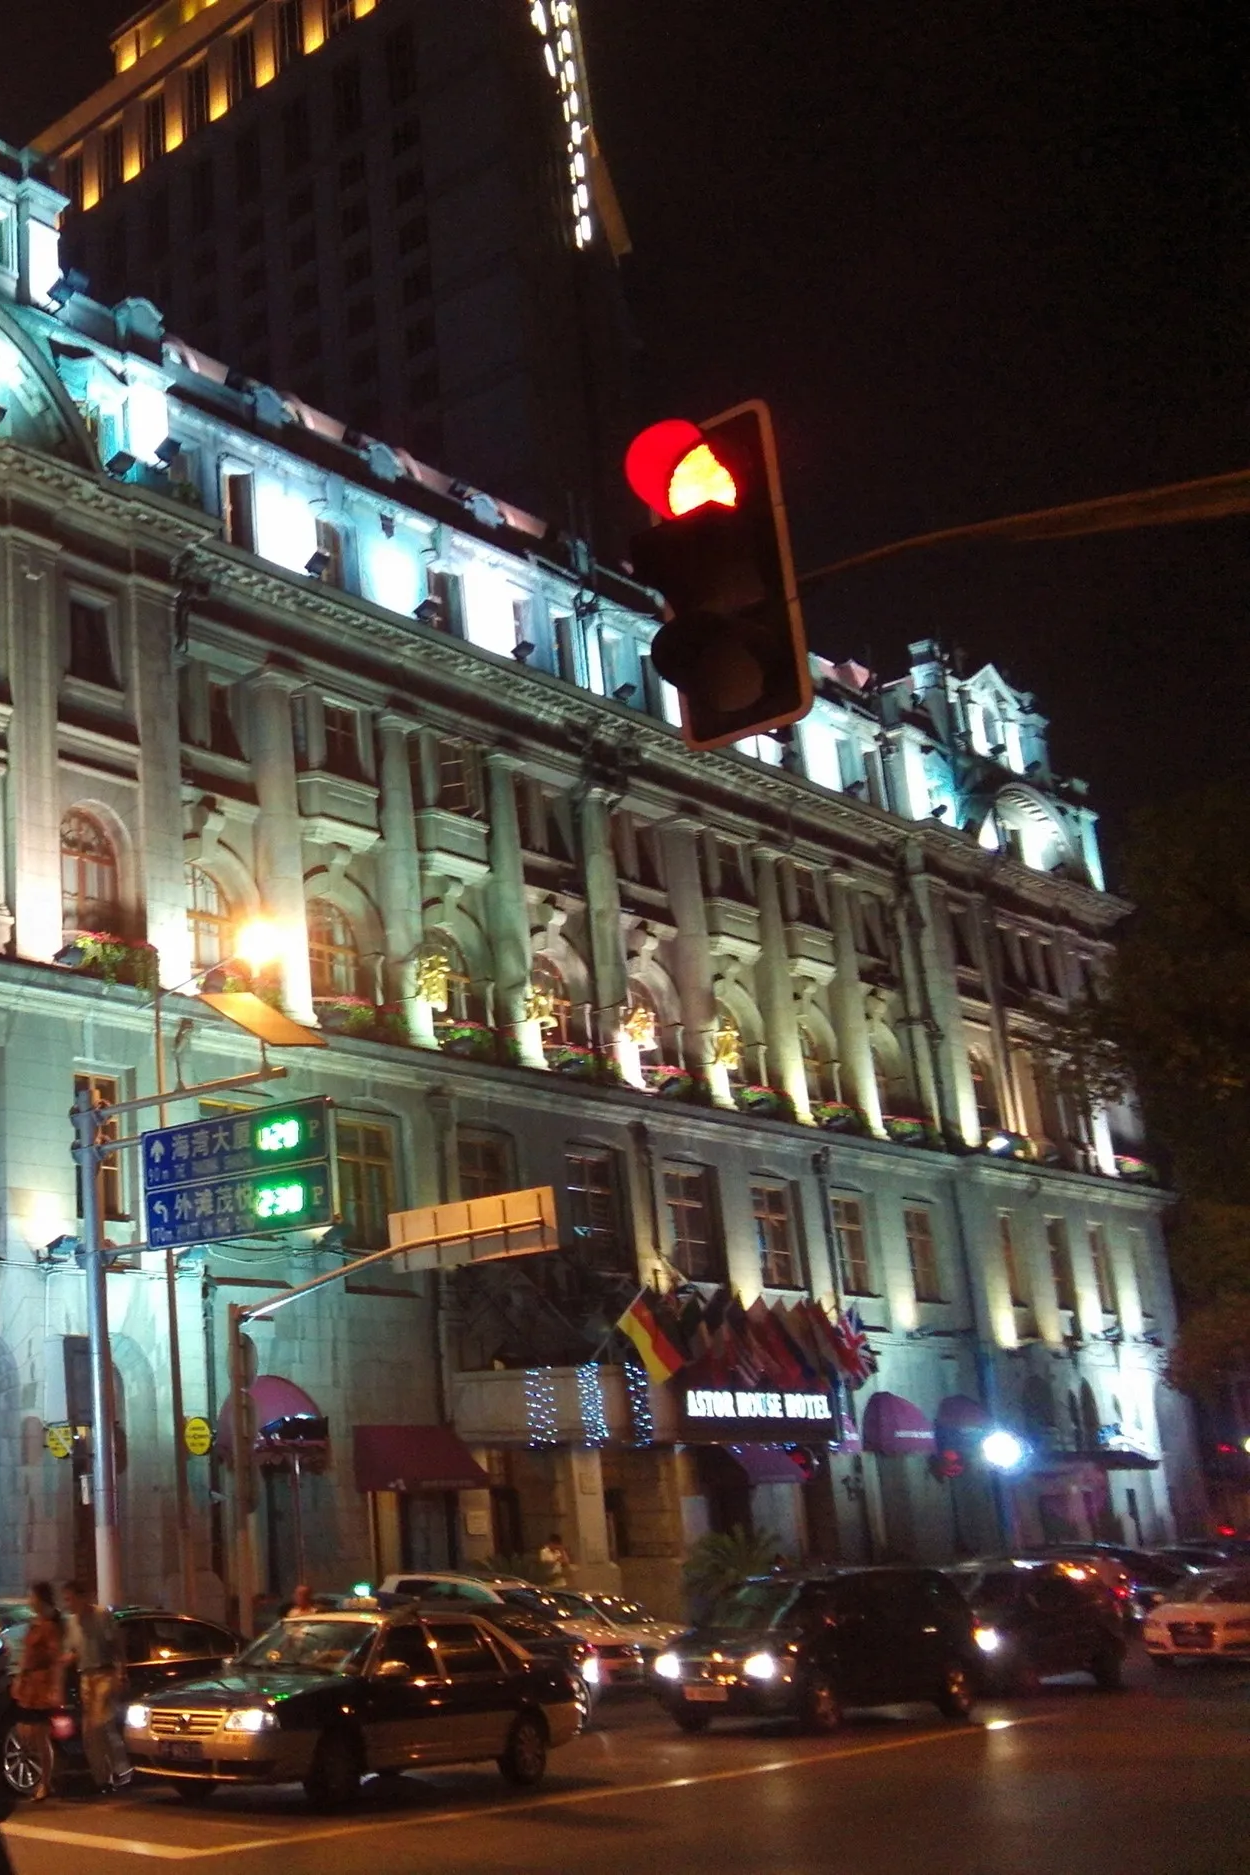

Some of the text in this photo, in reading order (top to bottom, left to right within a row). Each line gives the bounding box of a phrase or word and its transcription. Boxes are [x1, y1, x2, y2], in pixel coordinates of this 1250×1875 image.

[687, 1390, 832, 1419] ASTOR HOUSE HOTEL
